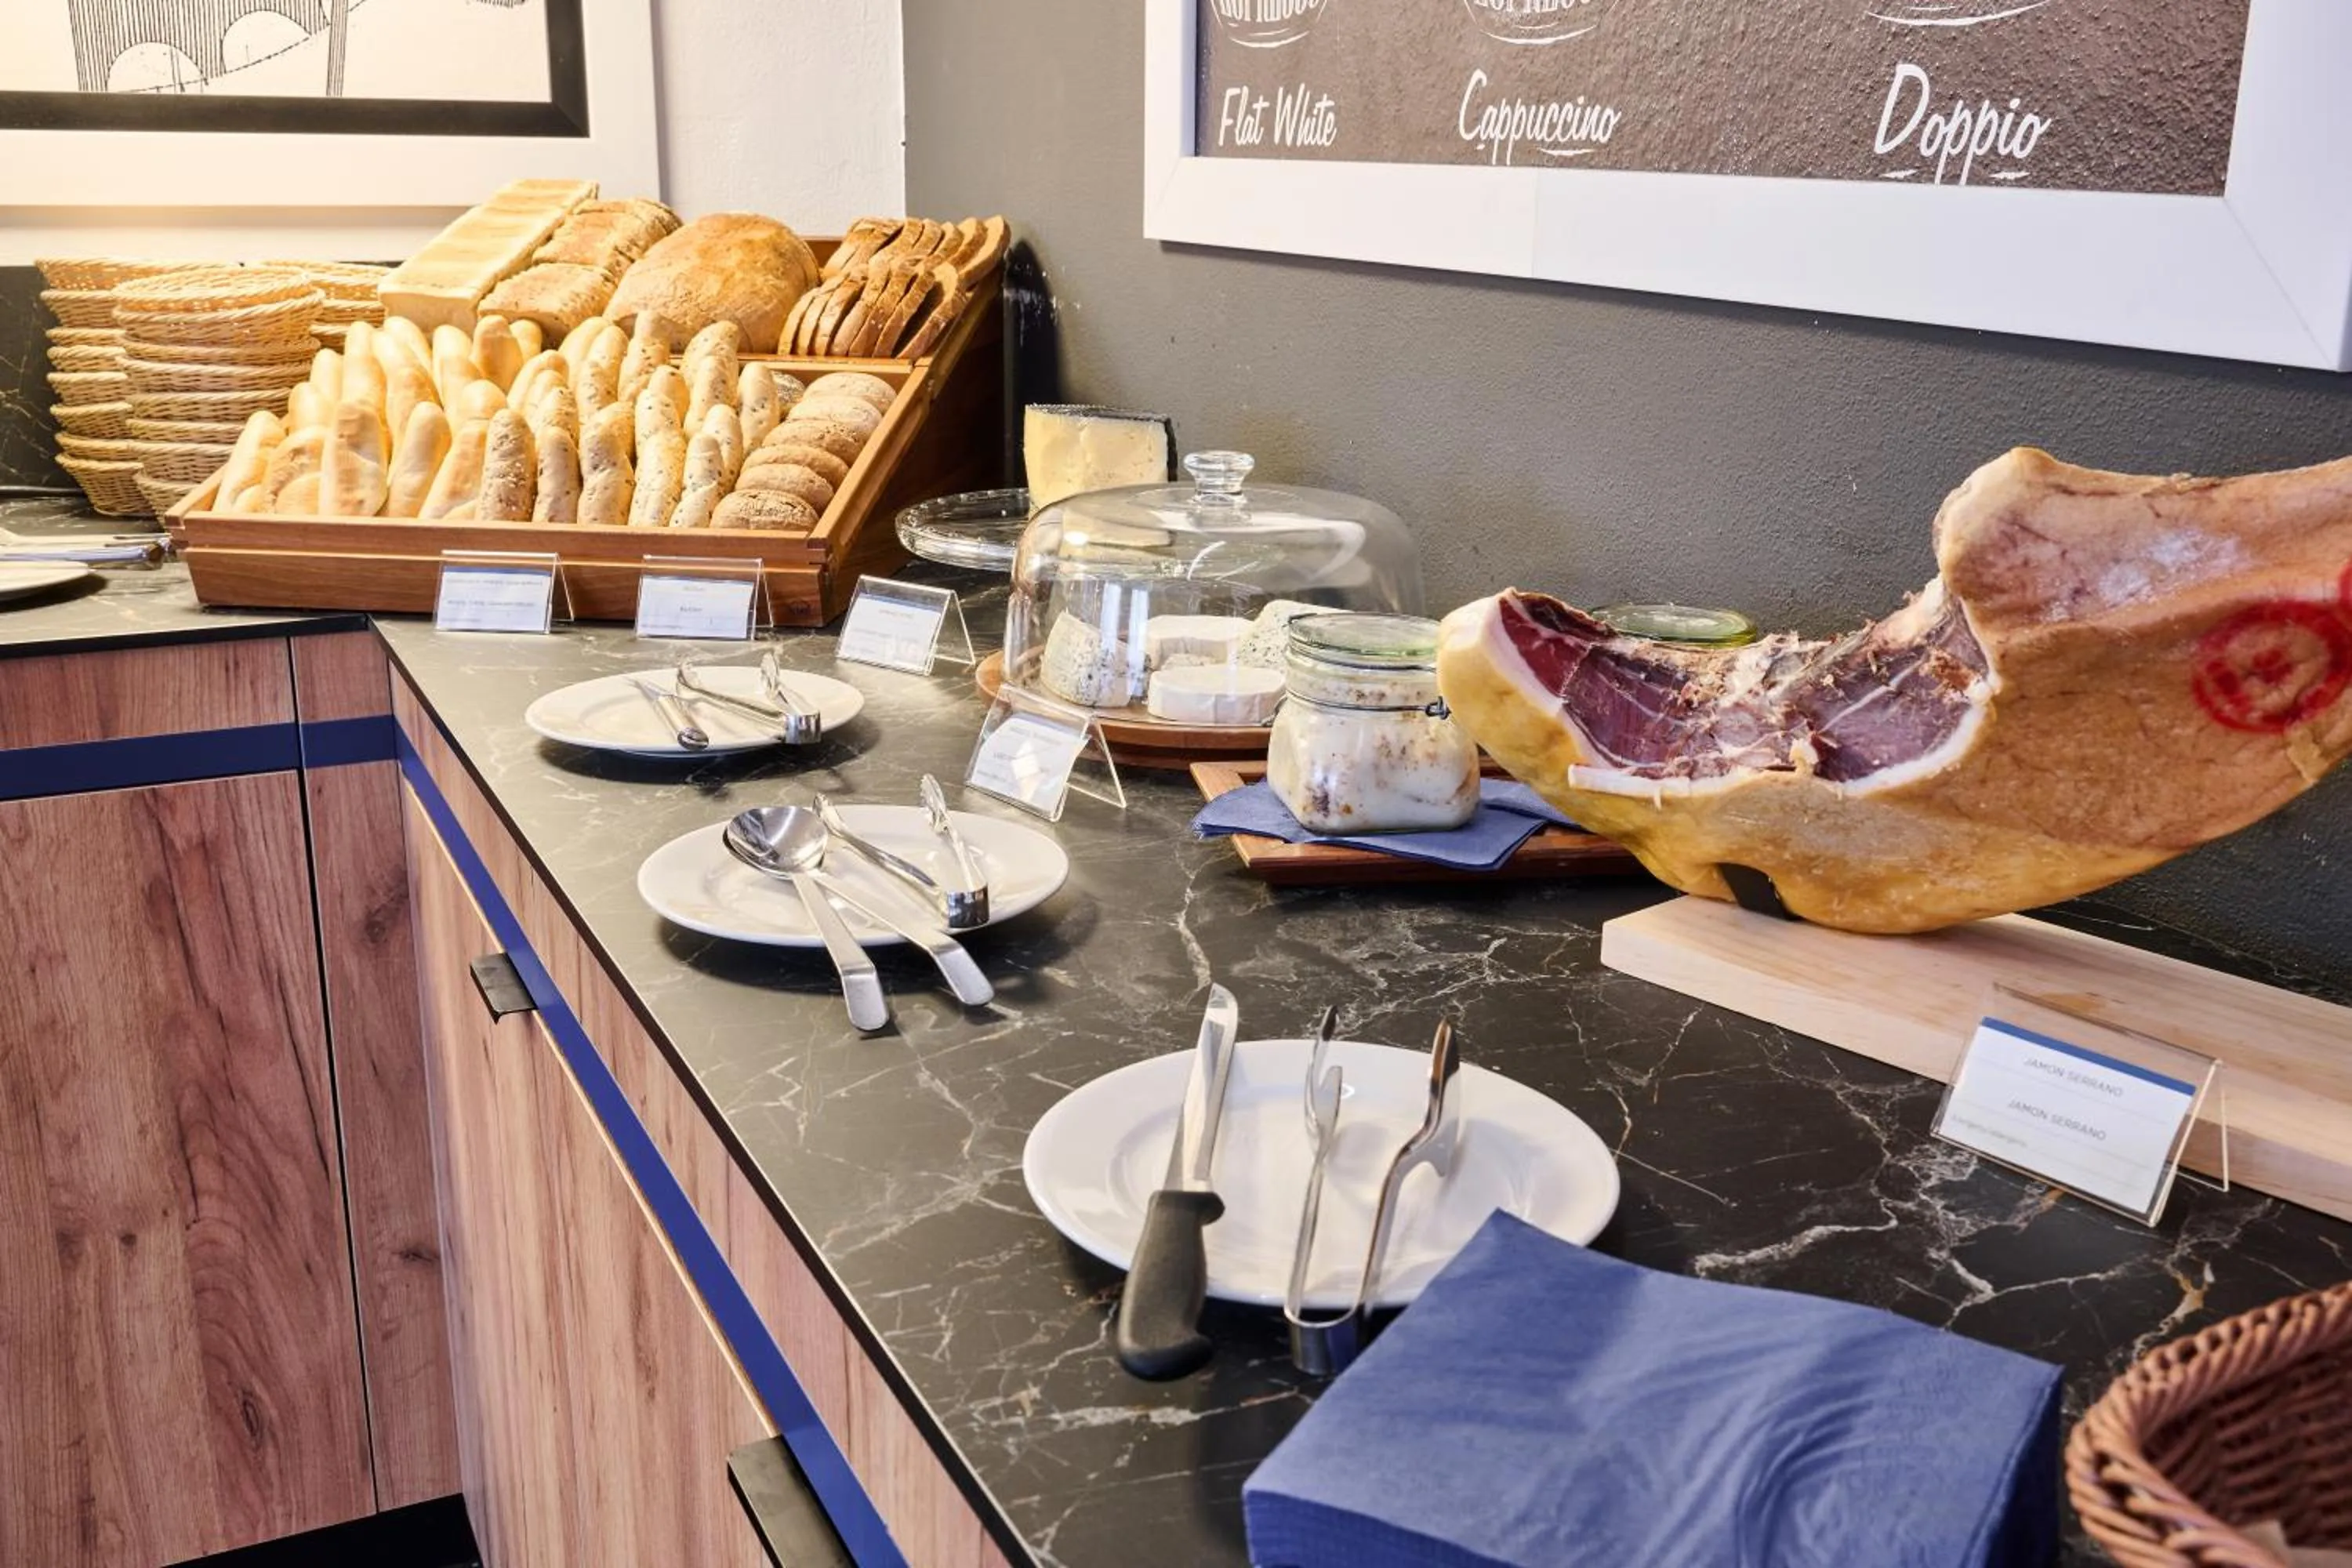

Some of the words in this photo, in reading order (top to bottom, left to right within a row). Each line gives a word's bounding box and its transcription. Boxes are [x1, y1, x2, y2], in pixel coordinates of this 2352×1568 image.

[1218, 86, 1269, 147] Flat
[1274, 82, 1337, 148] White
[1458, 69, 1621, 165] Cappuccino
[1874, 64, 2052, 184] Doppio
[2067, 1071, 2123, 1097] SERRANO
[2051, 1114, 2107, 1140] SERRANO
